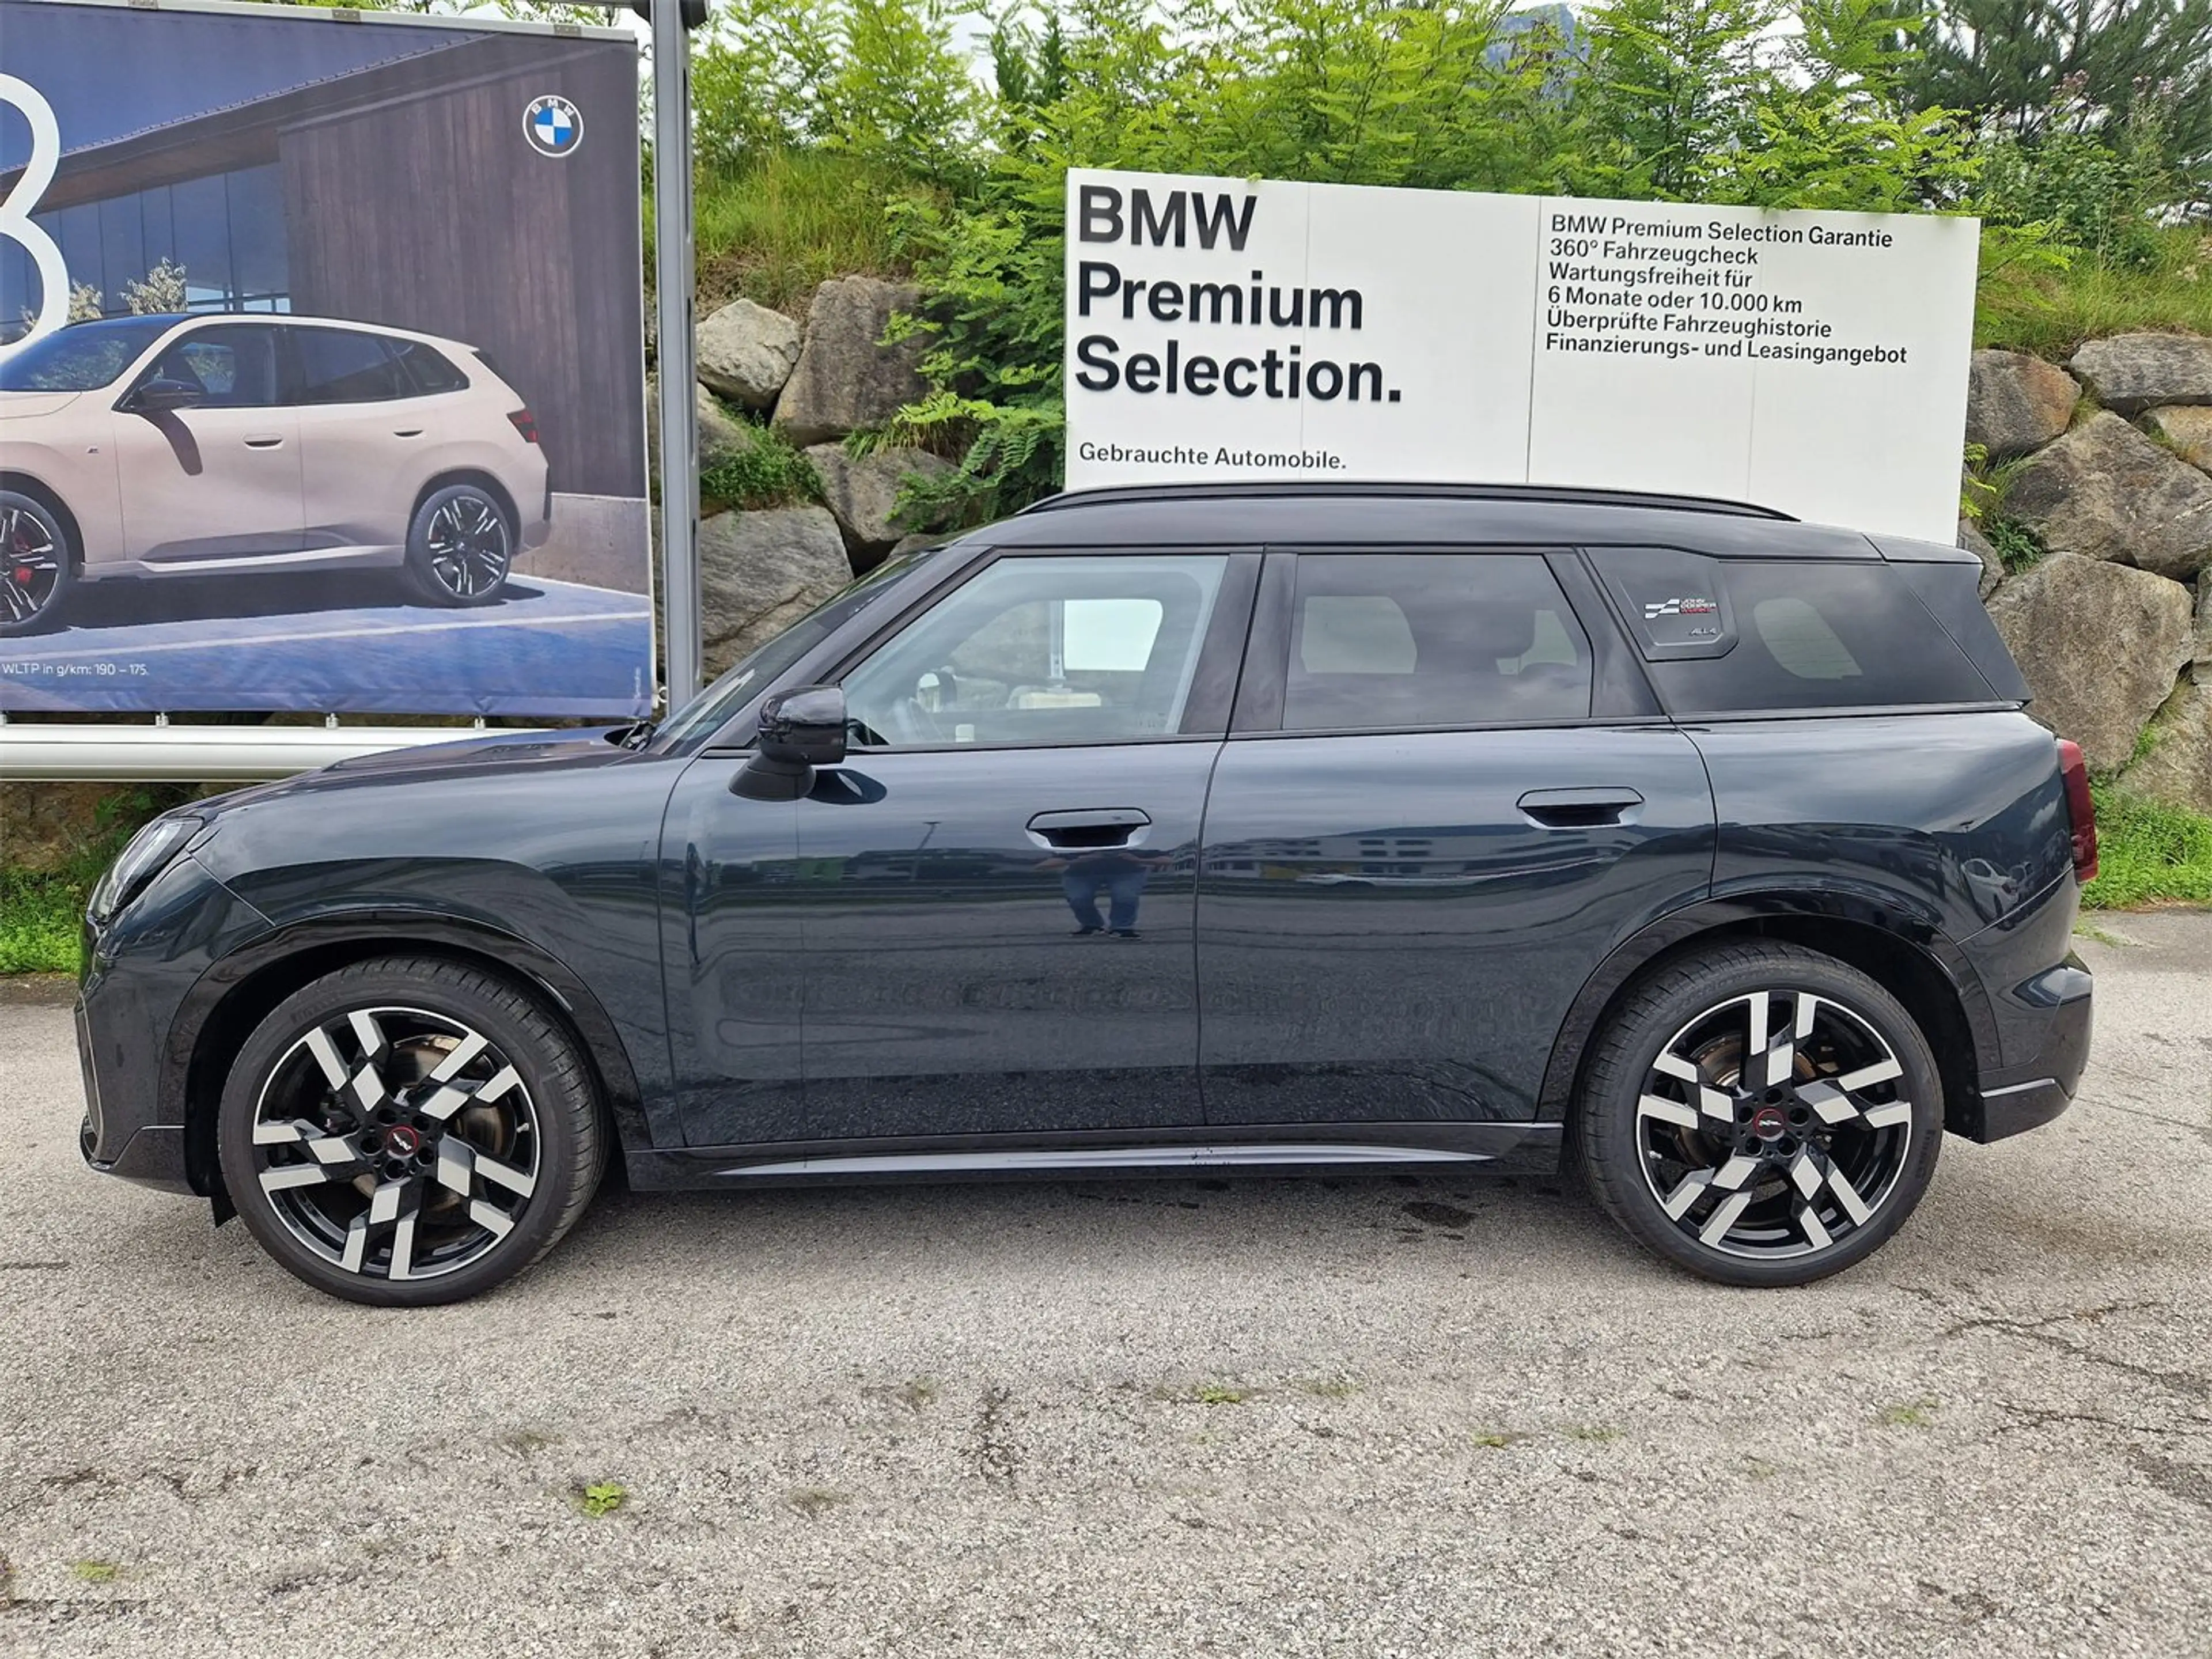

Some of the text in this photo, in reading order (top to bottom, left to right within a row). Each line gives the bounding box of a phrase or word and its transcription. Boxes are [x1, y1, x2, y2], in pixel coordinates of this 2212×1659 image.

[531, 98, 575, 116] BMW
[1080, 184, 1257, 251] BMW
[1552, 215, 1893, 248] BMW Premium Selection Garantie
[1551, 238, 1758, 267] 360° Fahrzeugcheck
[1550, 262, 1752, 287] Wartungsfreiheit für
[1079, 261, 1362, 330] Premium
[1548, 286, 1802, 313] 6 Monate oder 10.000 km
[1548, 305, 1832, 339] Überprüfte Fahrzeughistorie
[1547, 332, 1907, 366] Finanzierungs- und Leasingangebot
[1075, 335, 1401, 403] Selection.
[1080, 442, 1346, 469] Gebrauchte Automobile.
[2, 663, 39, 675] WLTP
[43, 664, 53, 675] in
[56, 664, 92, 677] g/km:
[94, 663, 116, 675] 190
